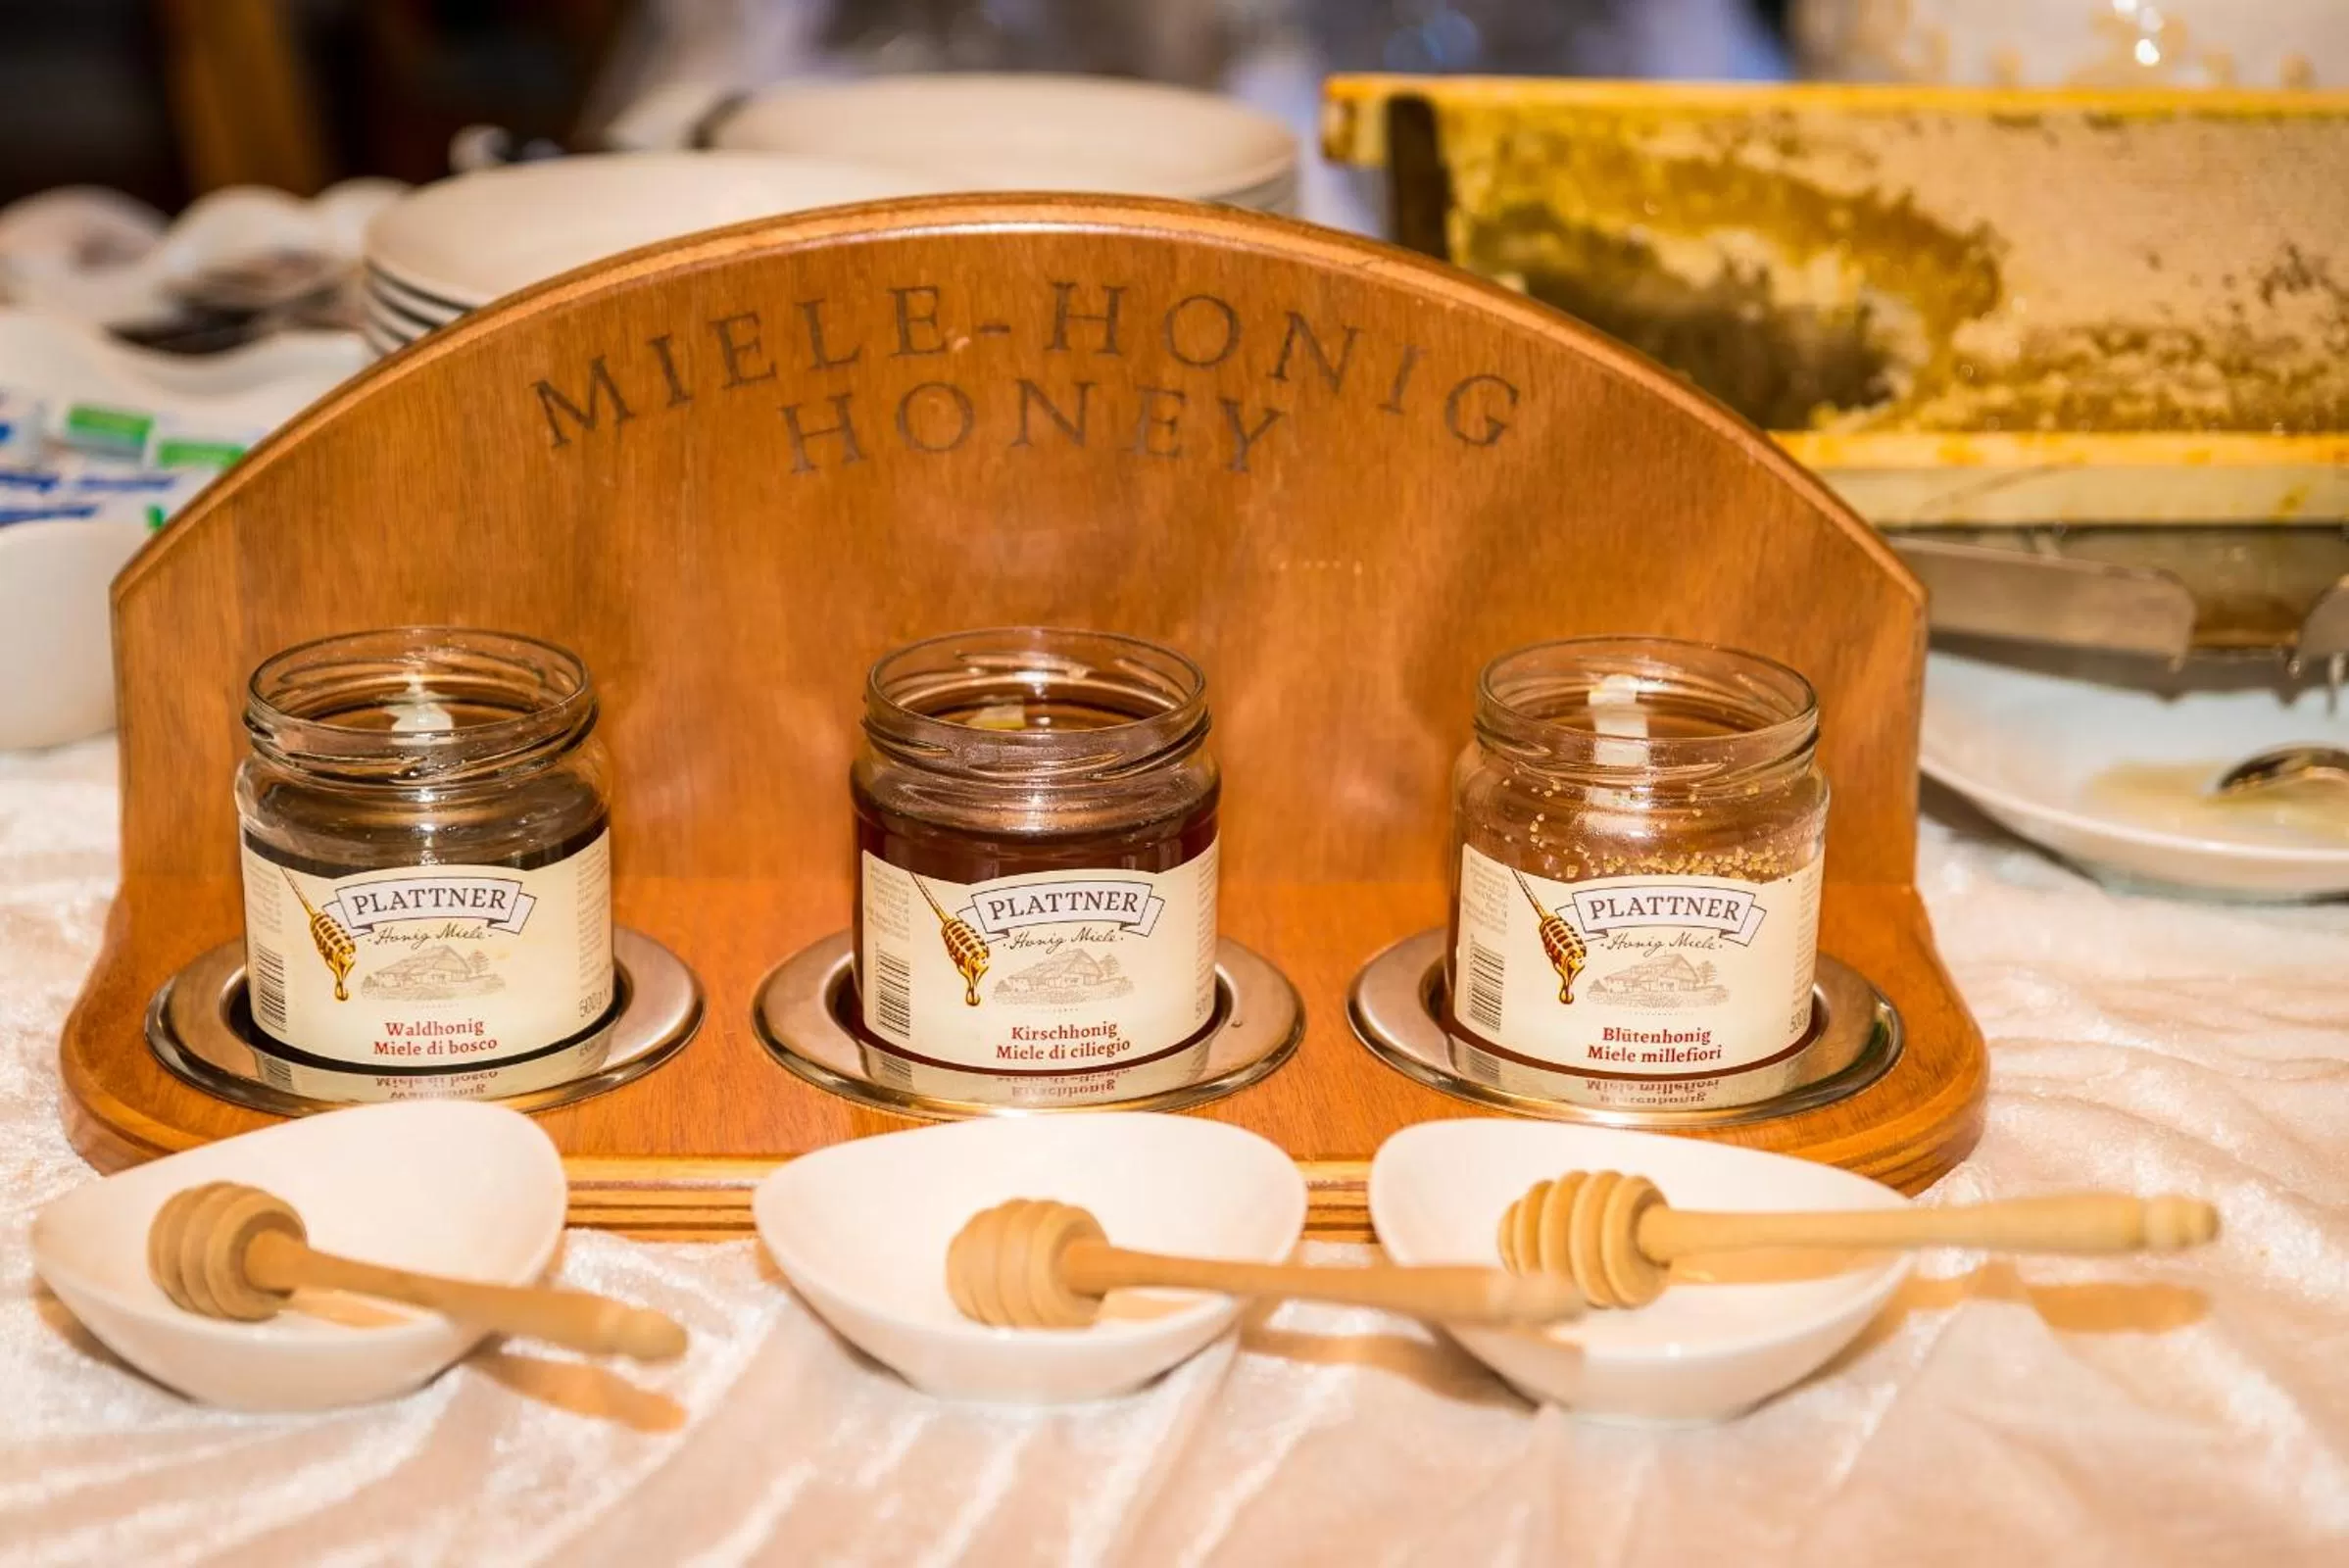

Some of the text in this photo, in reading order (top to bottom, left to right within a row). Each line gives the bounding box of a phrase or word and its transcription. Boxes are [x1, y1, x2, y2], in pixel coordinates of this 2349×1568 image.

[778, 379, 1285, 474] HONEY
[352, 887, 508, 915] PLATTNER
[988, 891, 1139, 920] PLATTNER
[1588, 896, 1740, 921] PLATTNER
[374, 921, 485, 950] Honig Miele
[1009, 926, 1118, 955] Honig Miele
[1606, 930, 1716, 958] Honig Miele
[384, 1018, 484, 1037] Waldhonig
[1011, 1020, 1117, 1041] Kirschhonig
[1602, 1026, 1711, 1046] Blütenhonig
[373, 1038, 498, 1056] Miele di bosco
[996, 1037, 1131, 1060] Miele di ciliegio
[1588, 1044, 1723, 1063] Miele millefiori
